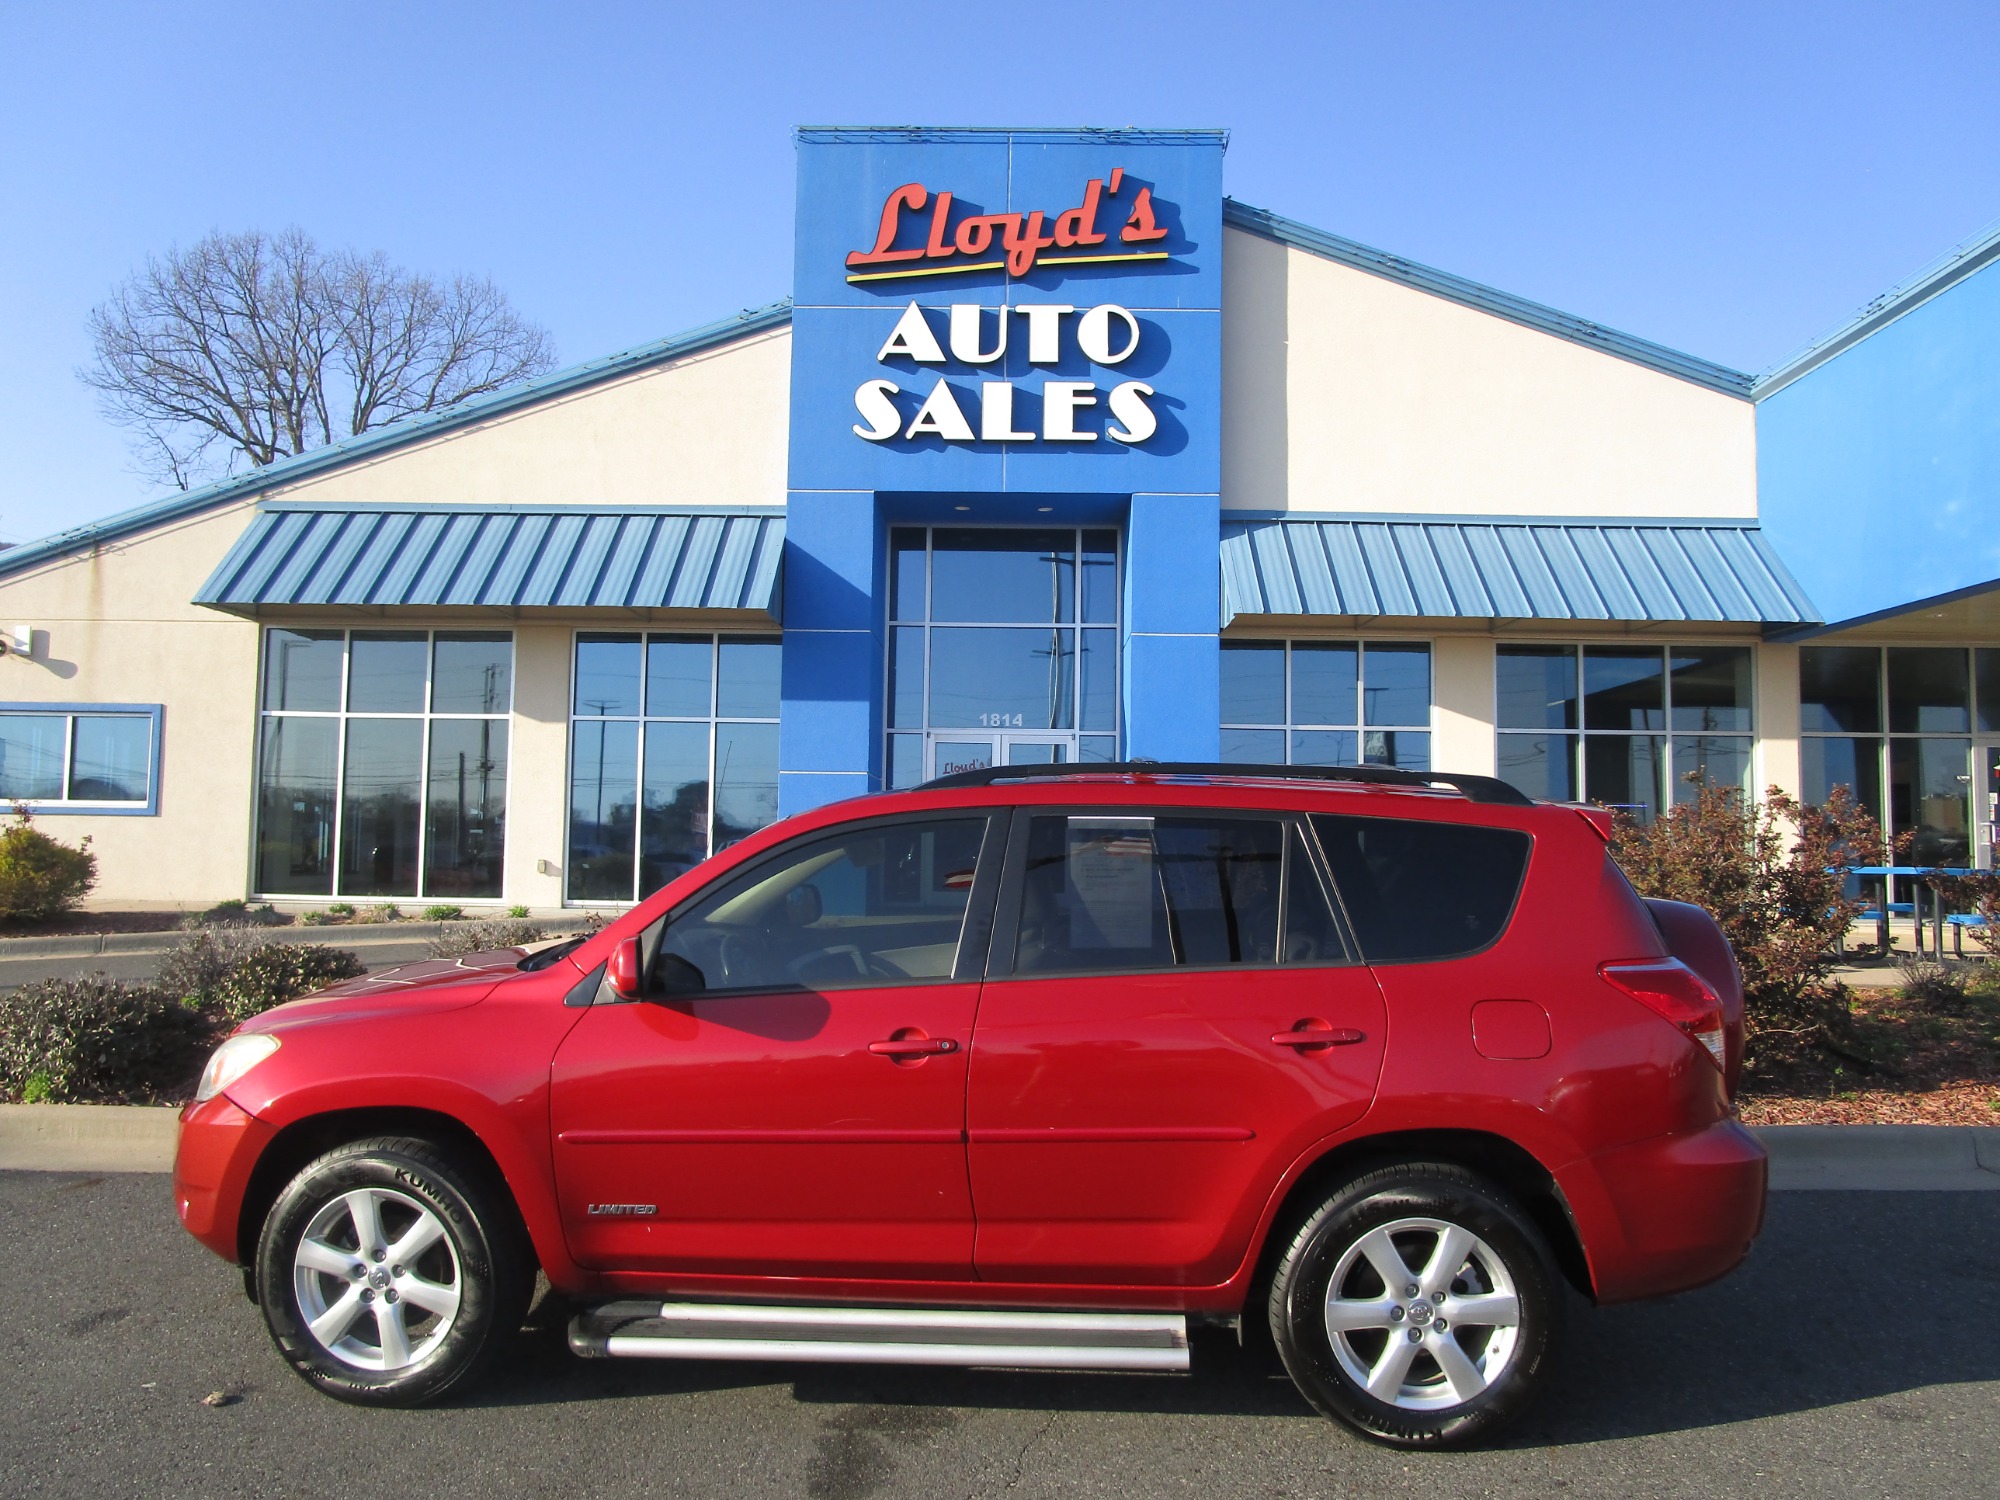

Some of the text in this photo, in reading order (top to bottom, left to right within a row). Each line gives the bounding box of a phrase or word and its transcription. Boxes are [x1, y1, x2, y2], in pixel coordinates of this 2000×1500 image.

[845, 168, 1169, 277] Lloyd's
[877, 300, 1140, 365] AUTO
[852, 377, 1157, 443] SALES
[979, 713, 1023, 727] 1814
[395, 1168, 462, 1223] KUMHO
[588, 1204, 657, 1214] LIMITED
